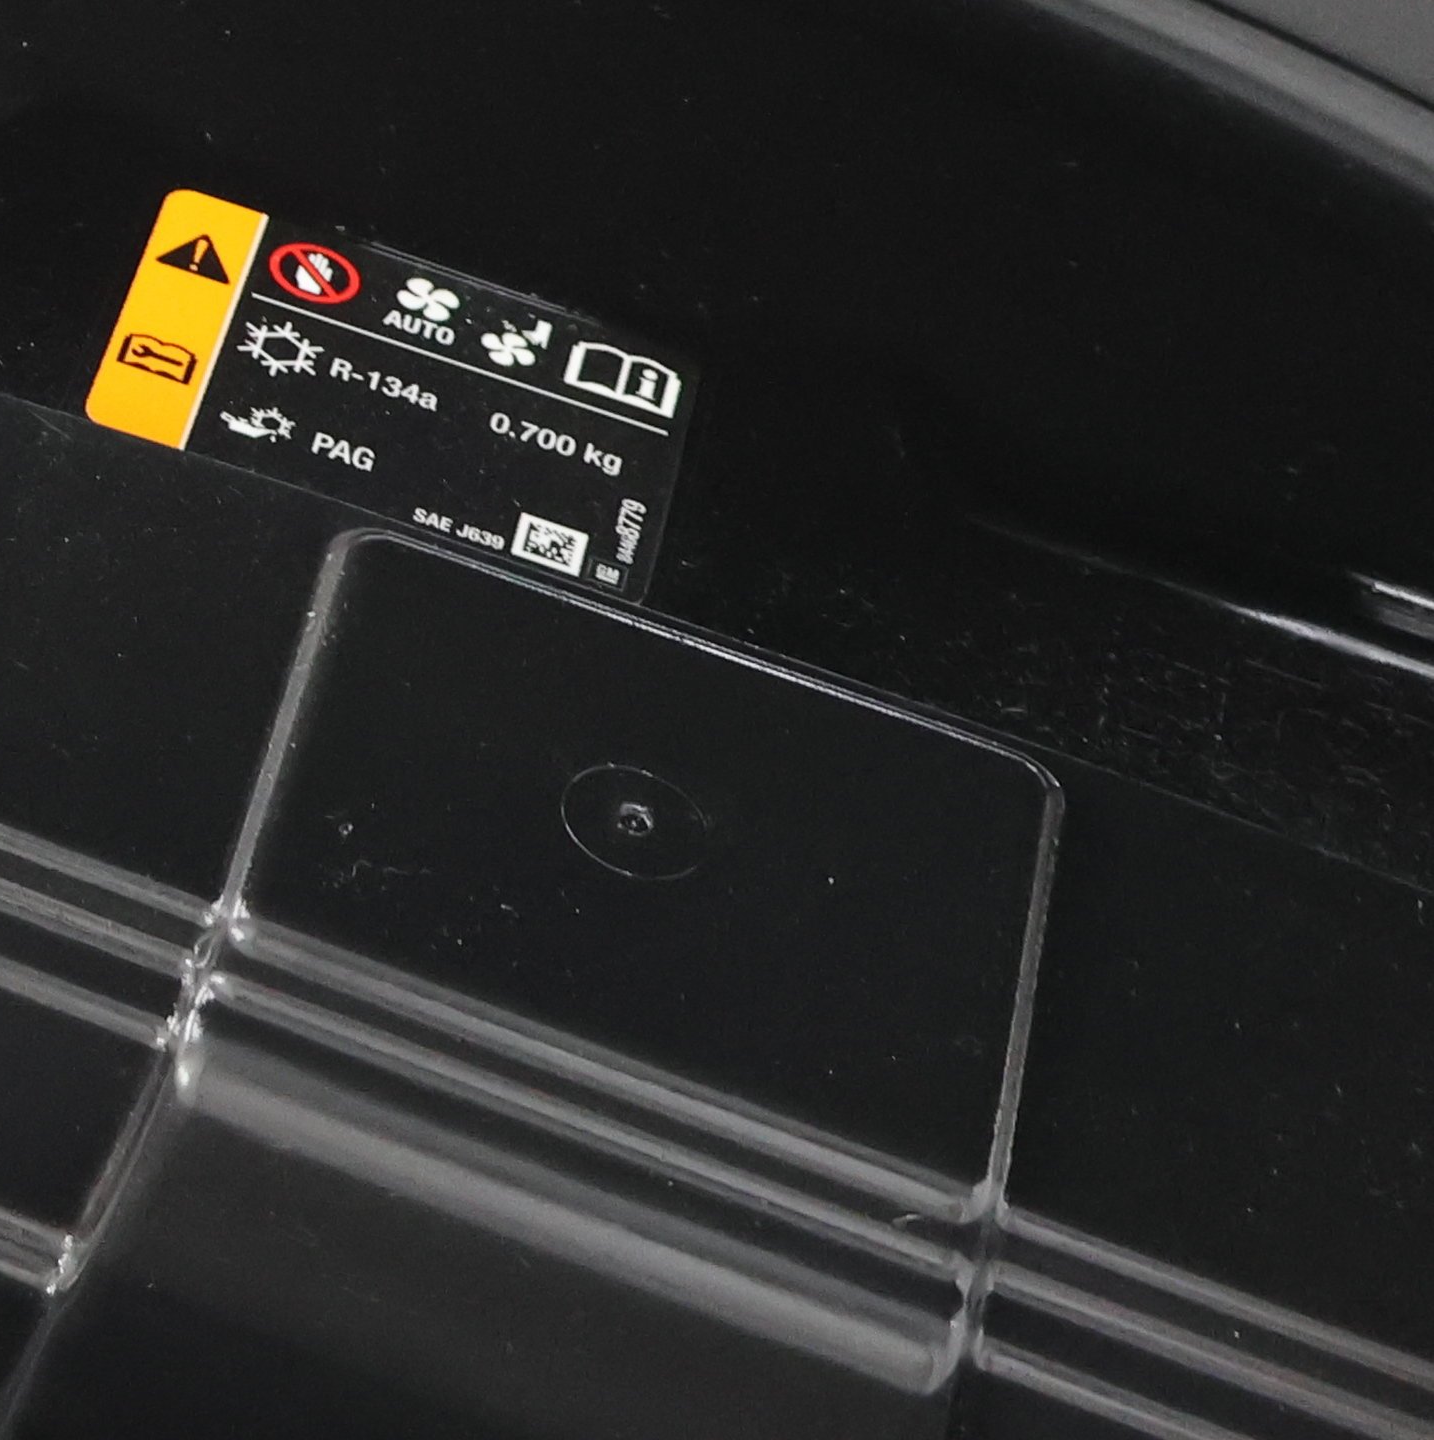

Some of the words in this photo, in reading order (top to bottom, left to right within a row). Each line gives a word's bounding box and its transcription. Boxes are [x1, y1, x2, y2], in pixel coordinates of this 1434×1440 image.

[383, 311, 455, 345] AUTO
[330, 358, 439, 411] R-134a
[490, 414, 575, 456] 0.700
[583, 443, 622, 476] kg
[312, 432, 376, 471] PAG
[413, 508, 452, 532] SAE
[456, 524, 505, 550] J639
